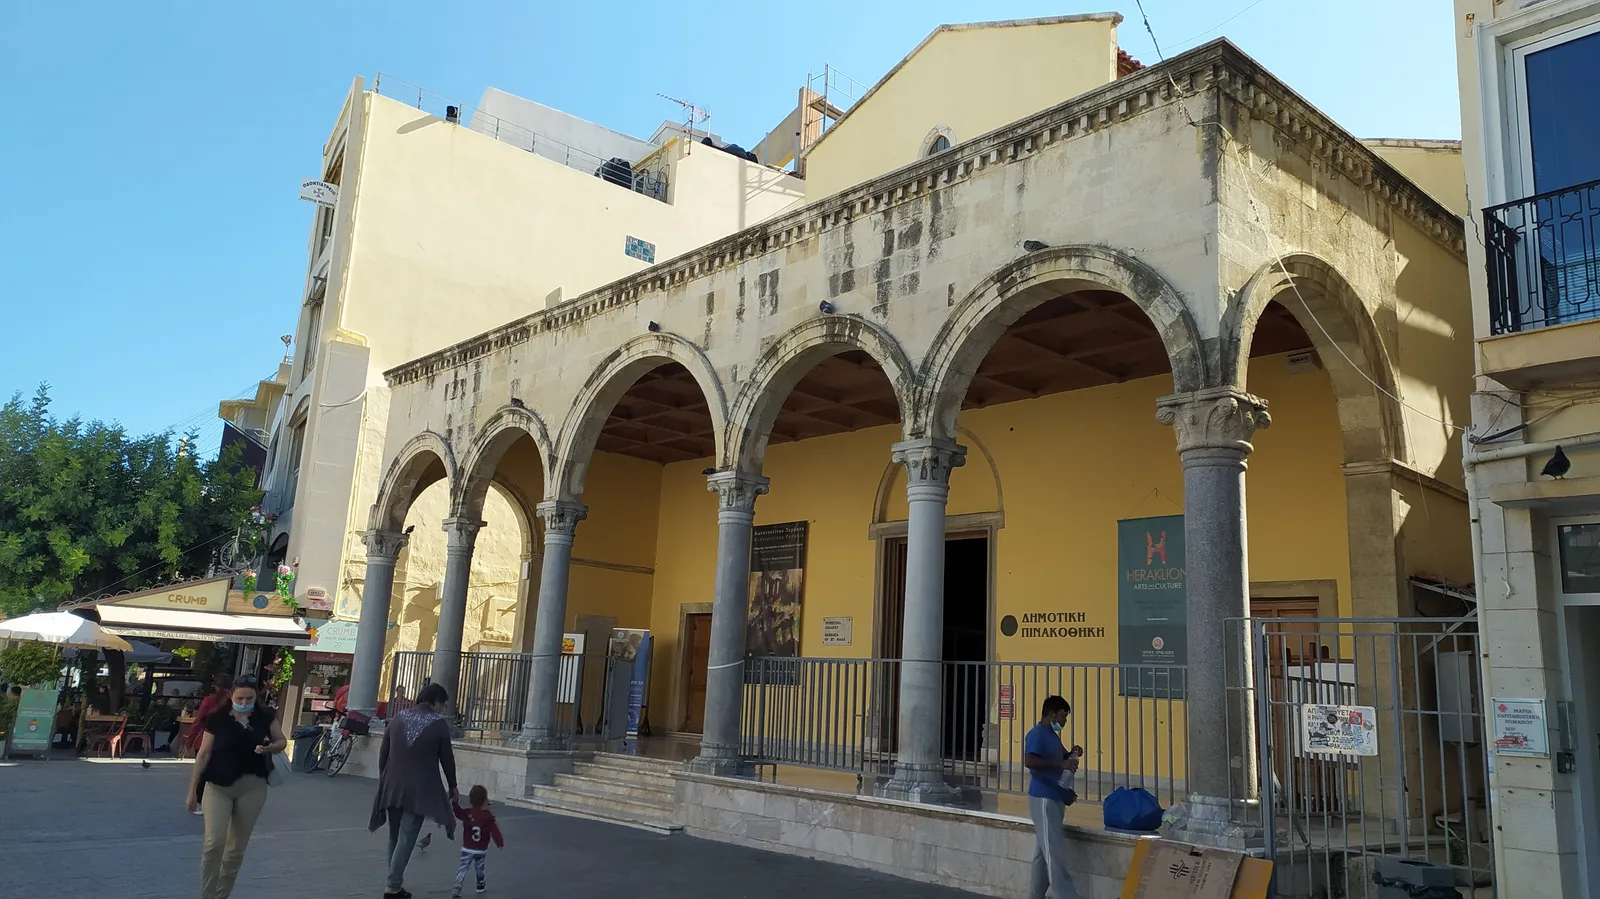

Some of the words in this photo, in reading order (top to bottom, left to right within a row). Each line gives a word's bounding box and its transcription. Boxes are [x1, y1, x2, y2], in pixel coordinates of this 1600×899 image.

[302, 181, 336, 195] ΟΔΟΝΤΙΑΤΡΕΙΟ
[1154, 582, 1182, 590] CULTURE
[167, 594, 208, 606] CRUMB
[1021, 612, 1086, 623] ΔΗΜΟΤΙΚΗ
[326, 627, 356, 637] CRUMB
[1021, 627, 1105, 638] ΠΙΝΑΚΟΘΗΚΗ
[471, 826, 482, 842] 3
